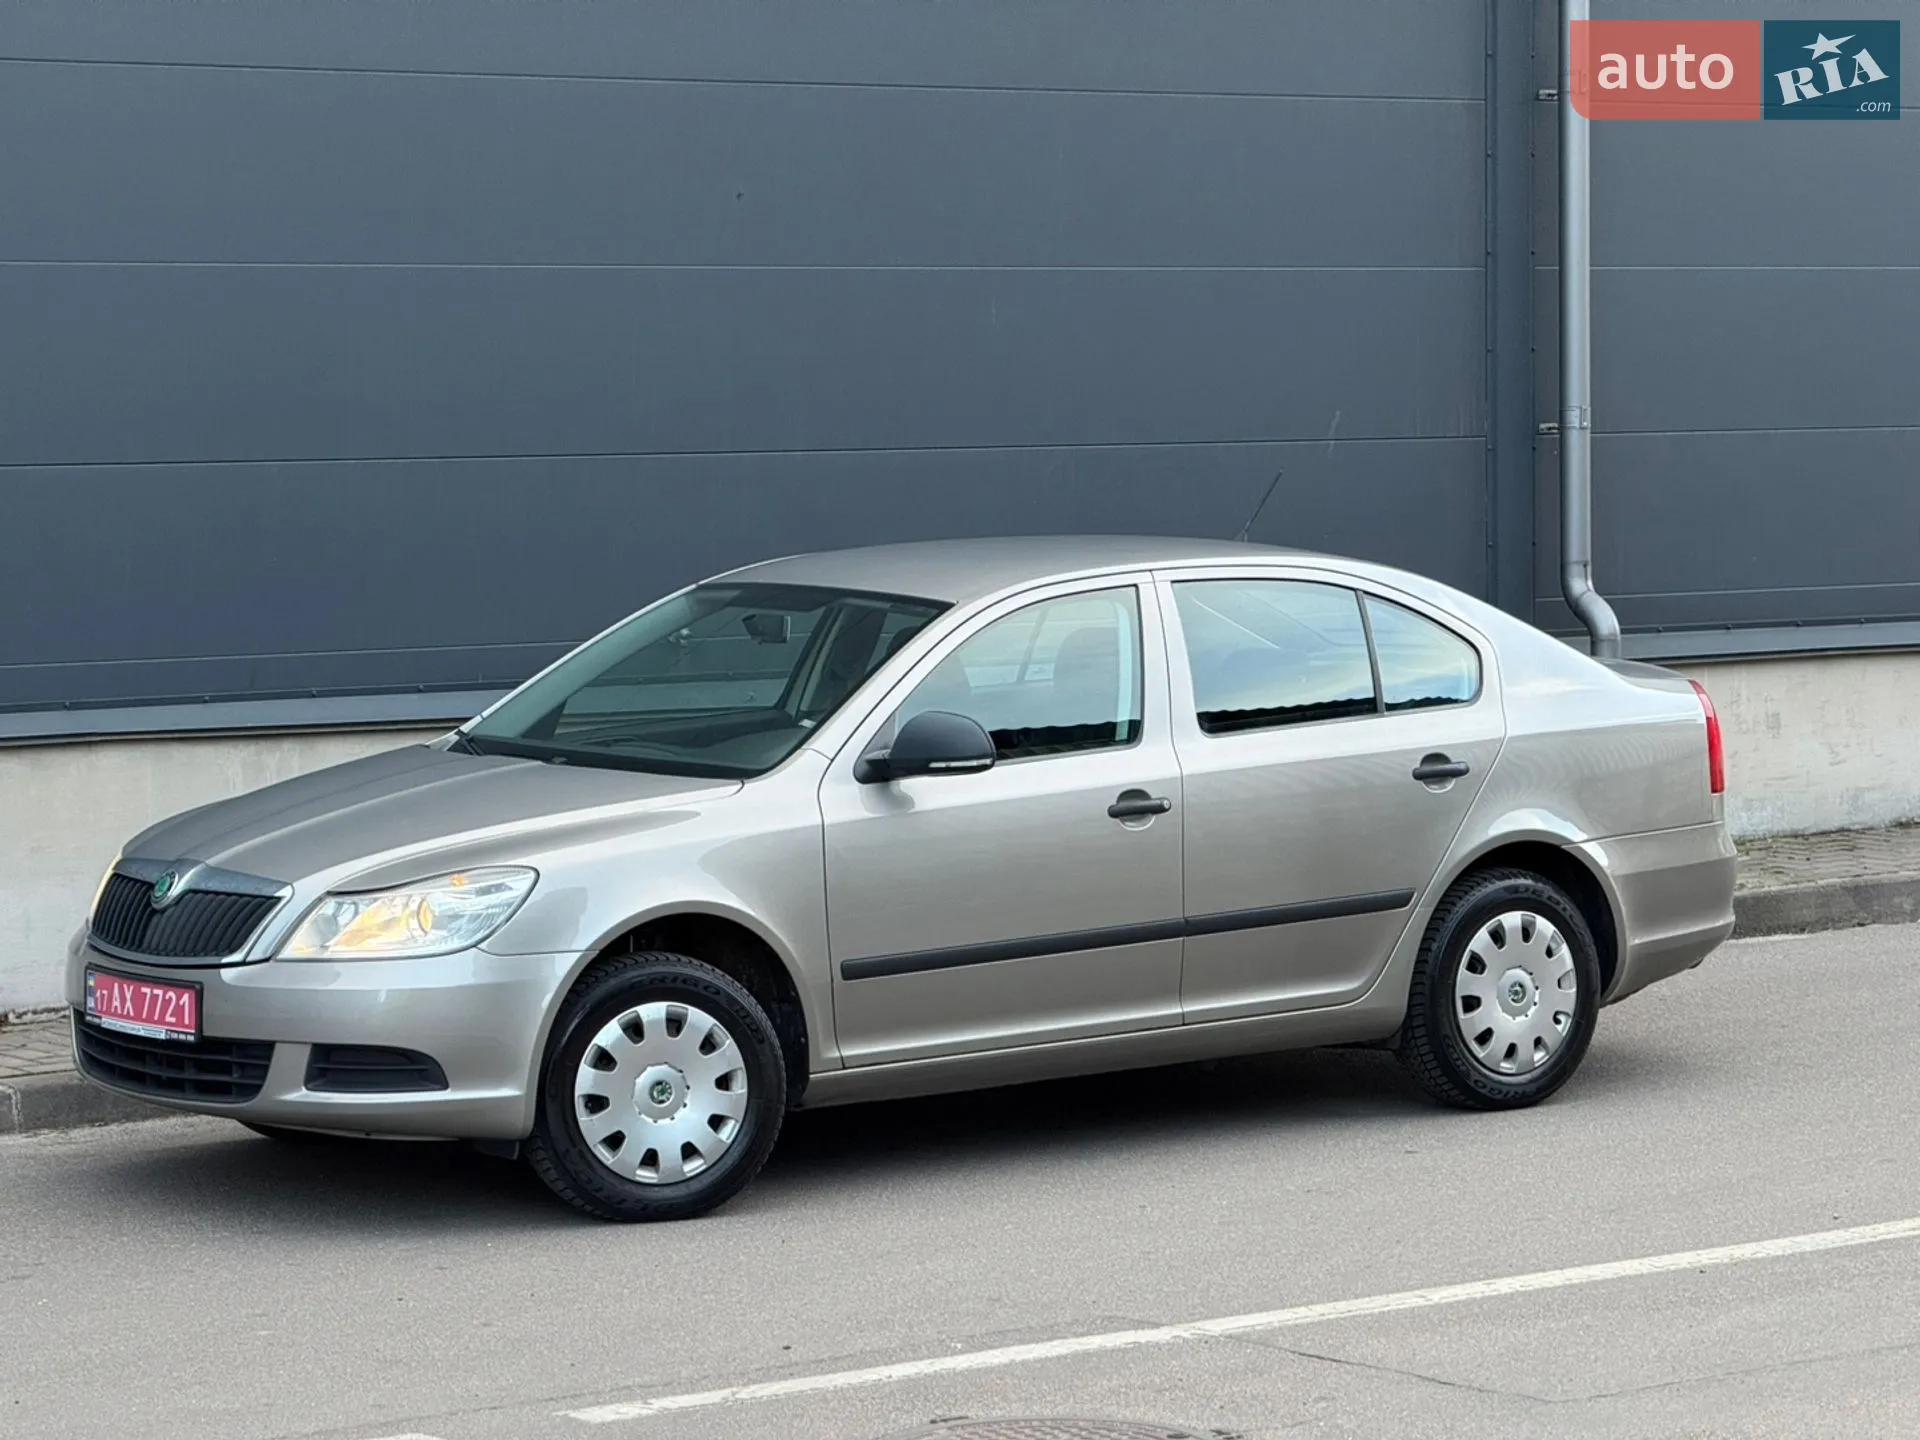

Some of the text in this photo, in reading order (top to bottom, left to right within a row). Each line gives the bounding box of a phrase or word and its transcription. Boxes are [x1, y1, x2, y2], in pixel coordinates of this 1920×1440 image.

[95, 982, 190, 1025] 17 AX 7721
